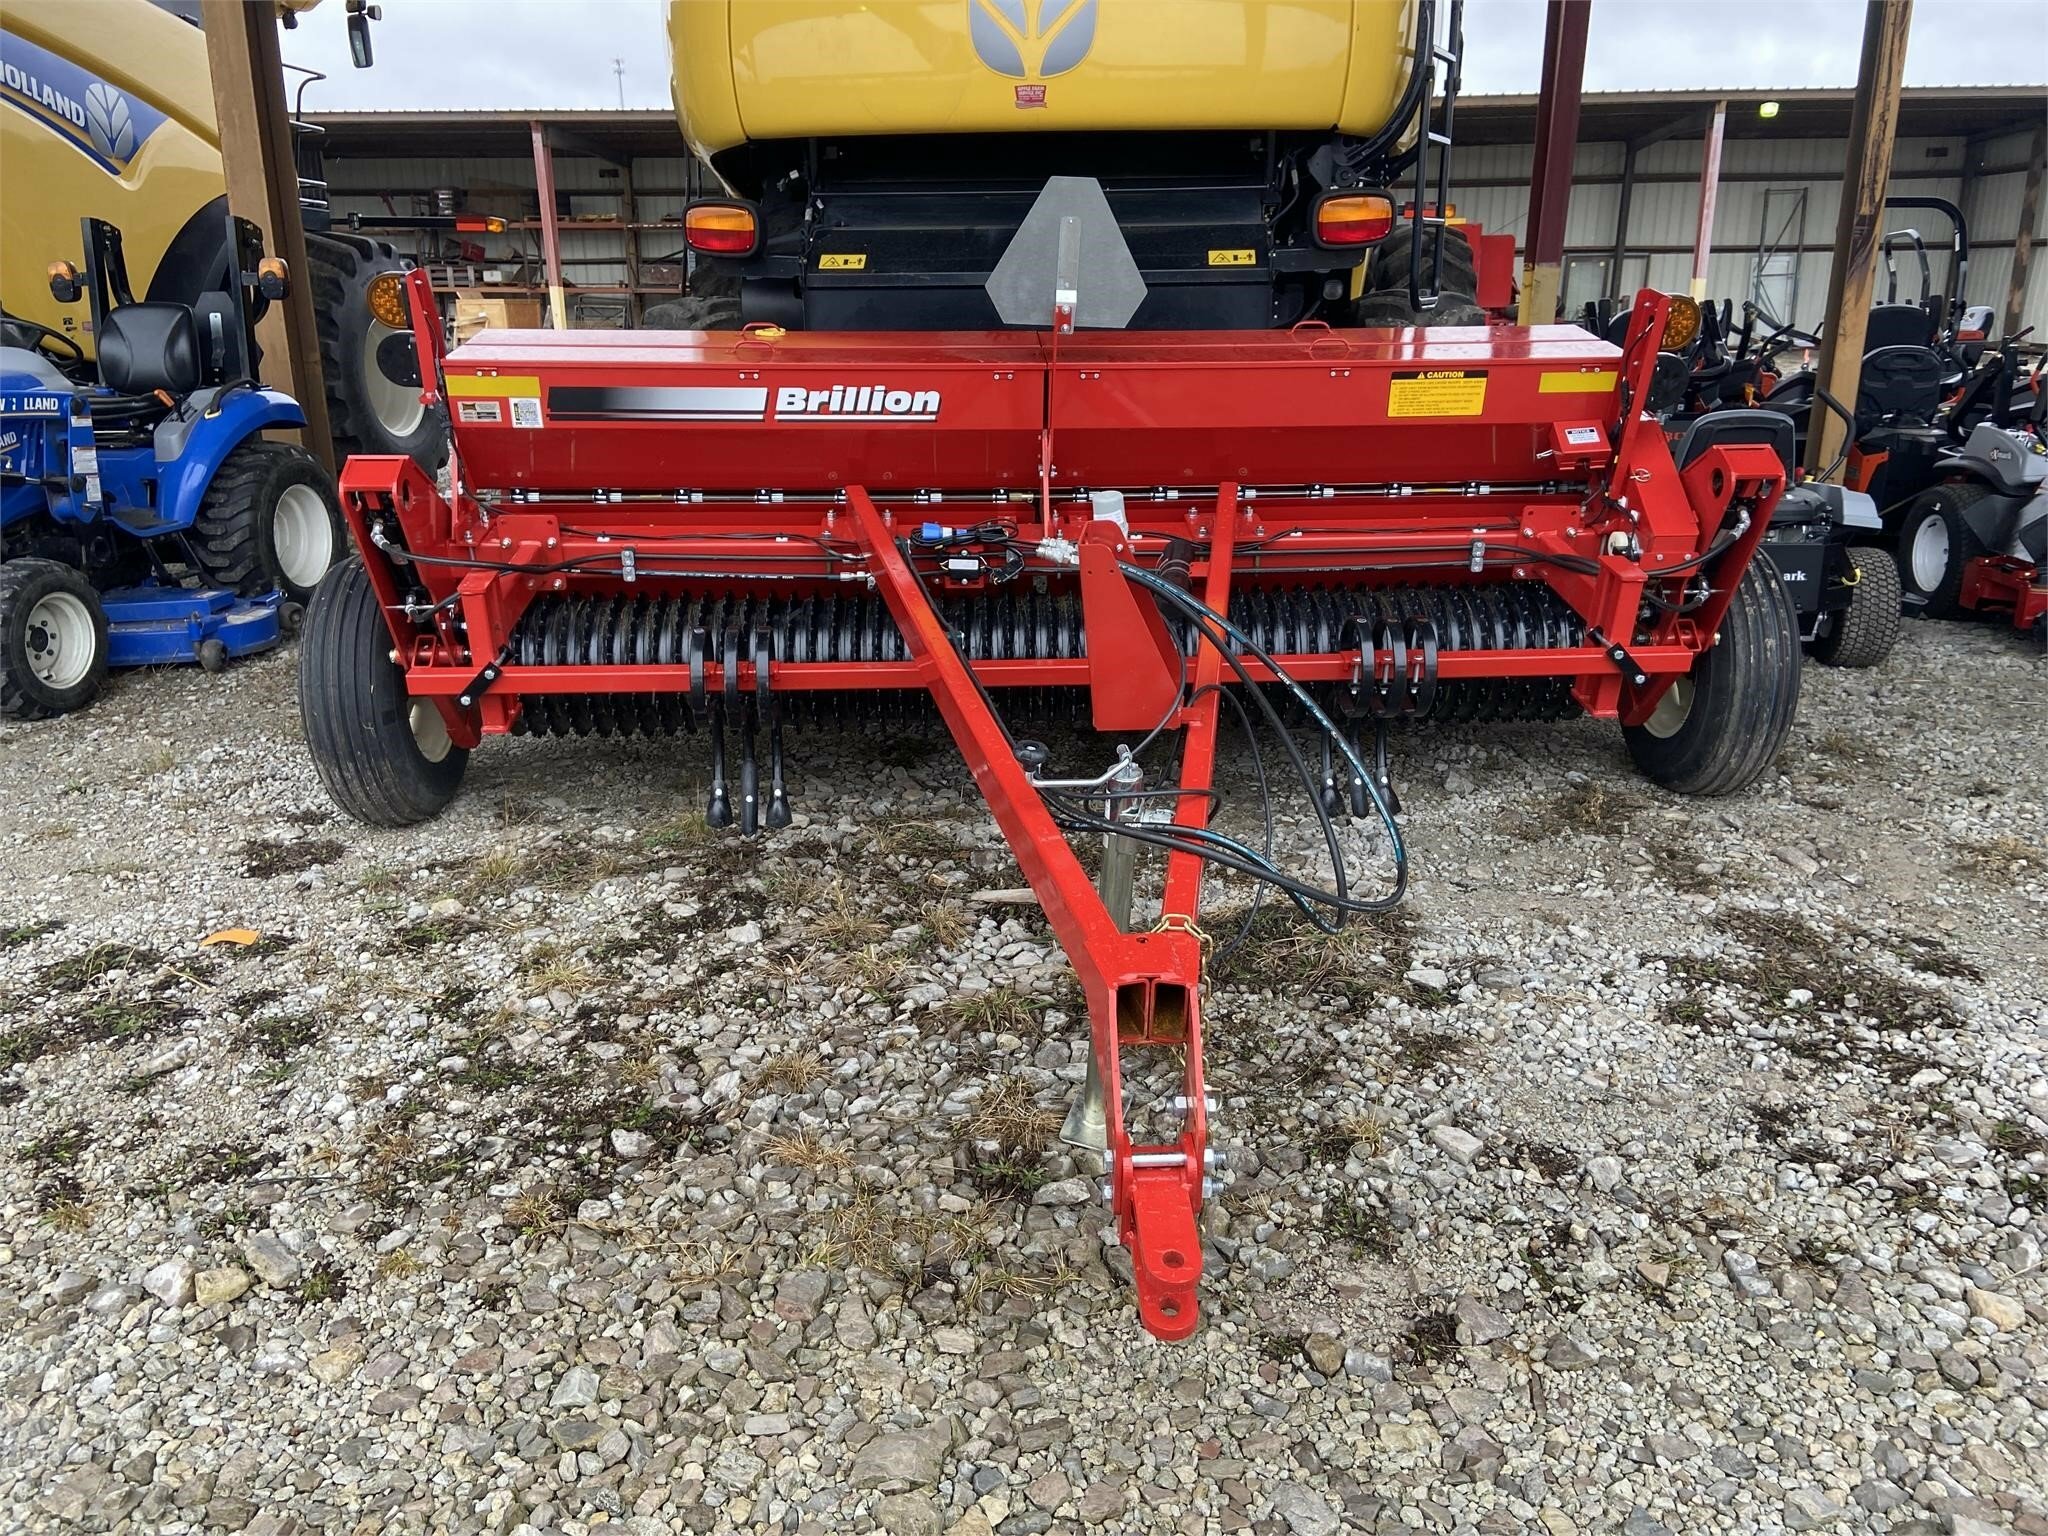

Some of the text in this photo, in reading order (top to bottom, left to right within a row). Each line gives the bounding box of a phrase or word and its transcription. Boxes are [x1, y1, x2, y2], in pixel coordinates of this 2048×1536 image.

[1426, 371, 1465, 379] CAUTION
[775, 385, 941, 414] Brillion
[1783, 570, 1806, 581] ark
